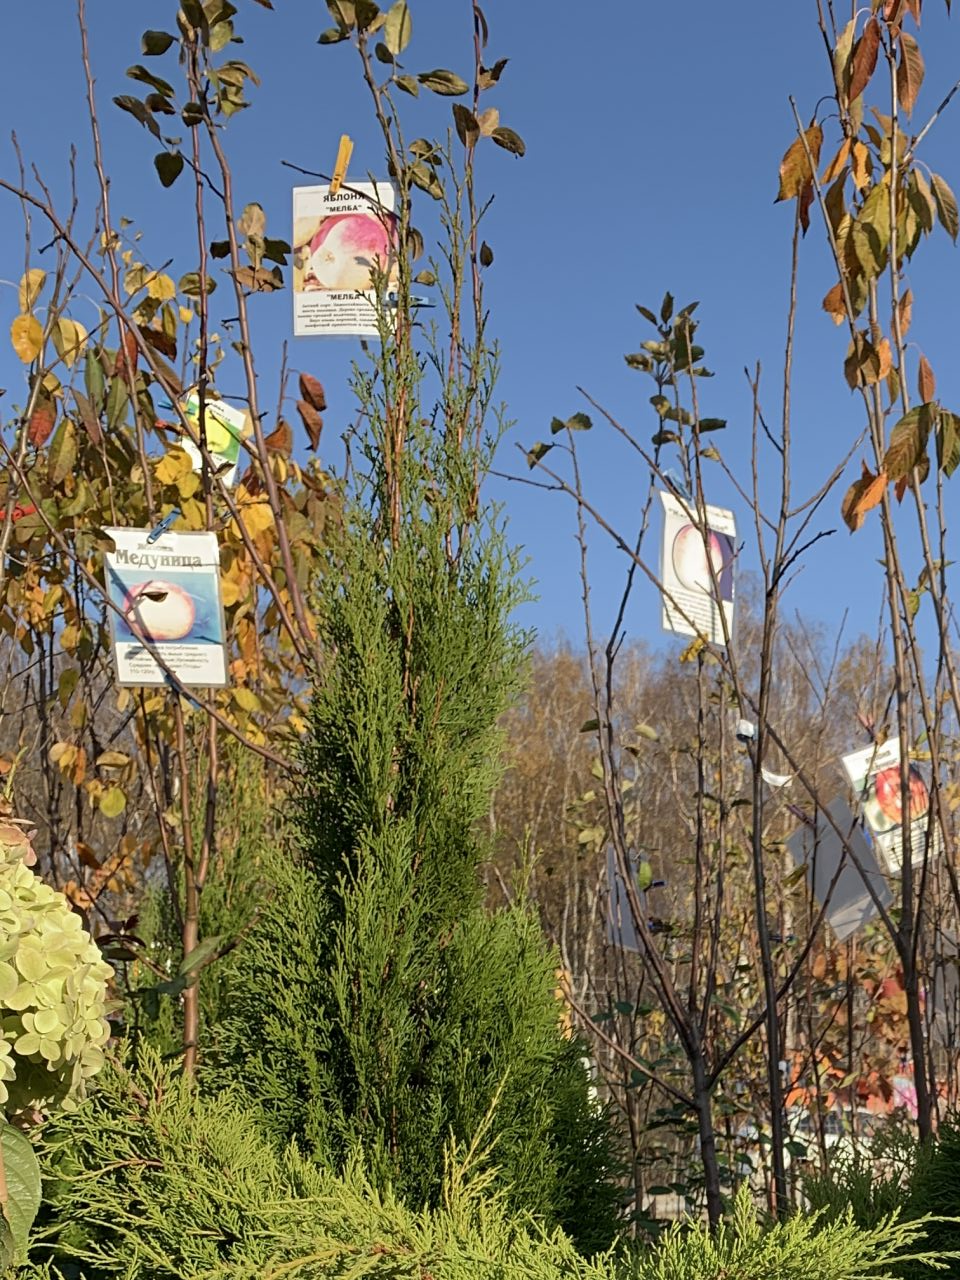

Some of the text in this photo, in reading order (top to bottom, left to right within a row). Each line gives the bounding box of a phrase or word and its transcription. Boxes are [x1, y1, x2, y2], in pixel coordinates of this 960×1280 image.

[323, 193, 365, 202] ЯБЛОНЯ
[325, 204, 362, 212] "МЕЛБА"
[326, 293, 361, 301] "МЕЛБА
[116, 549, 202, 570] Медуница
